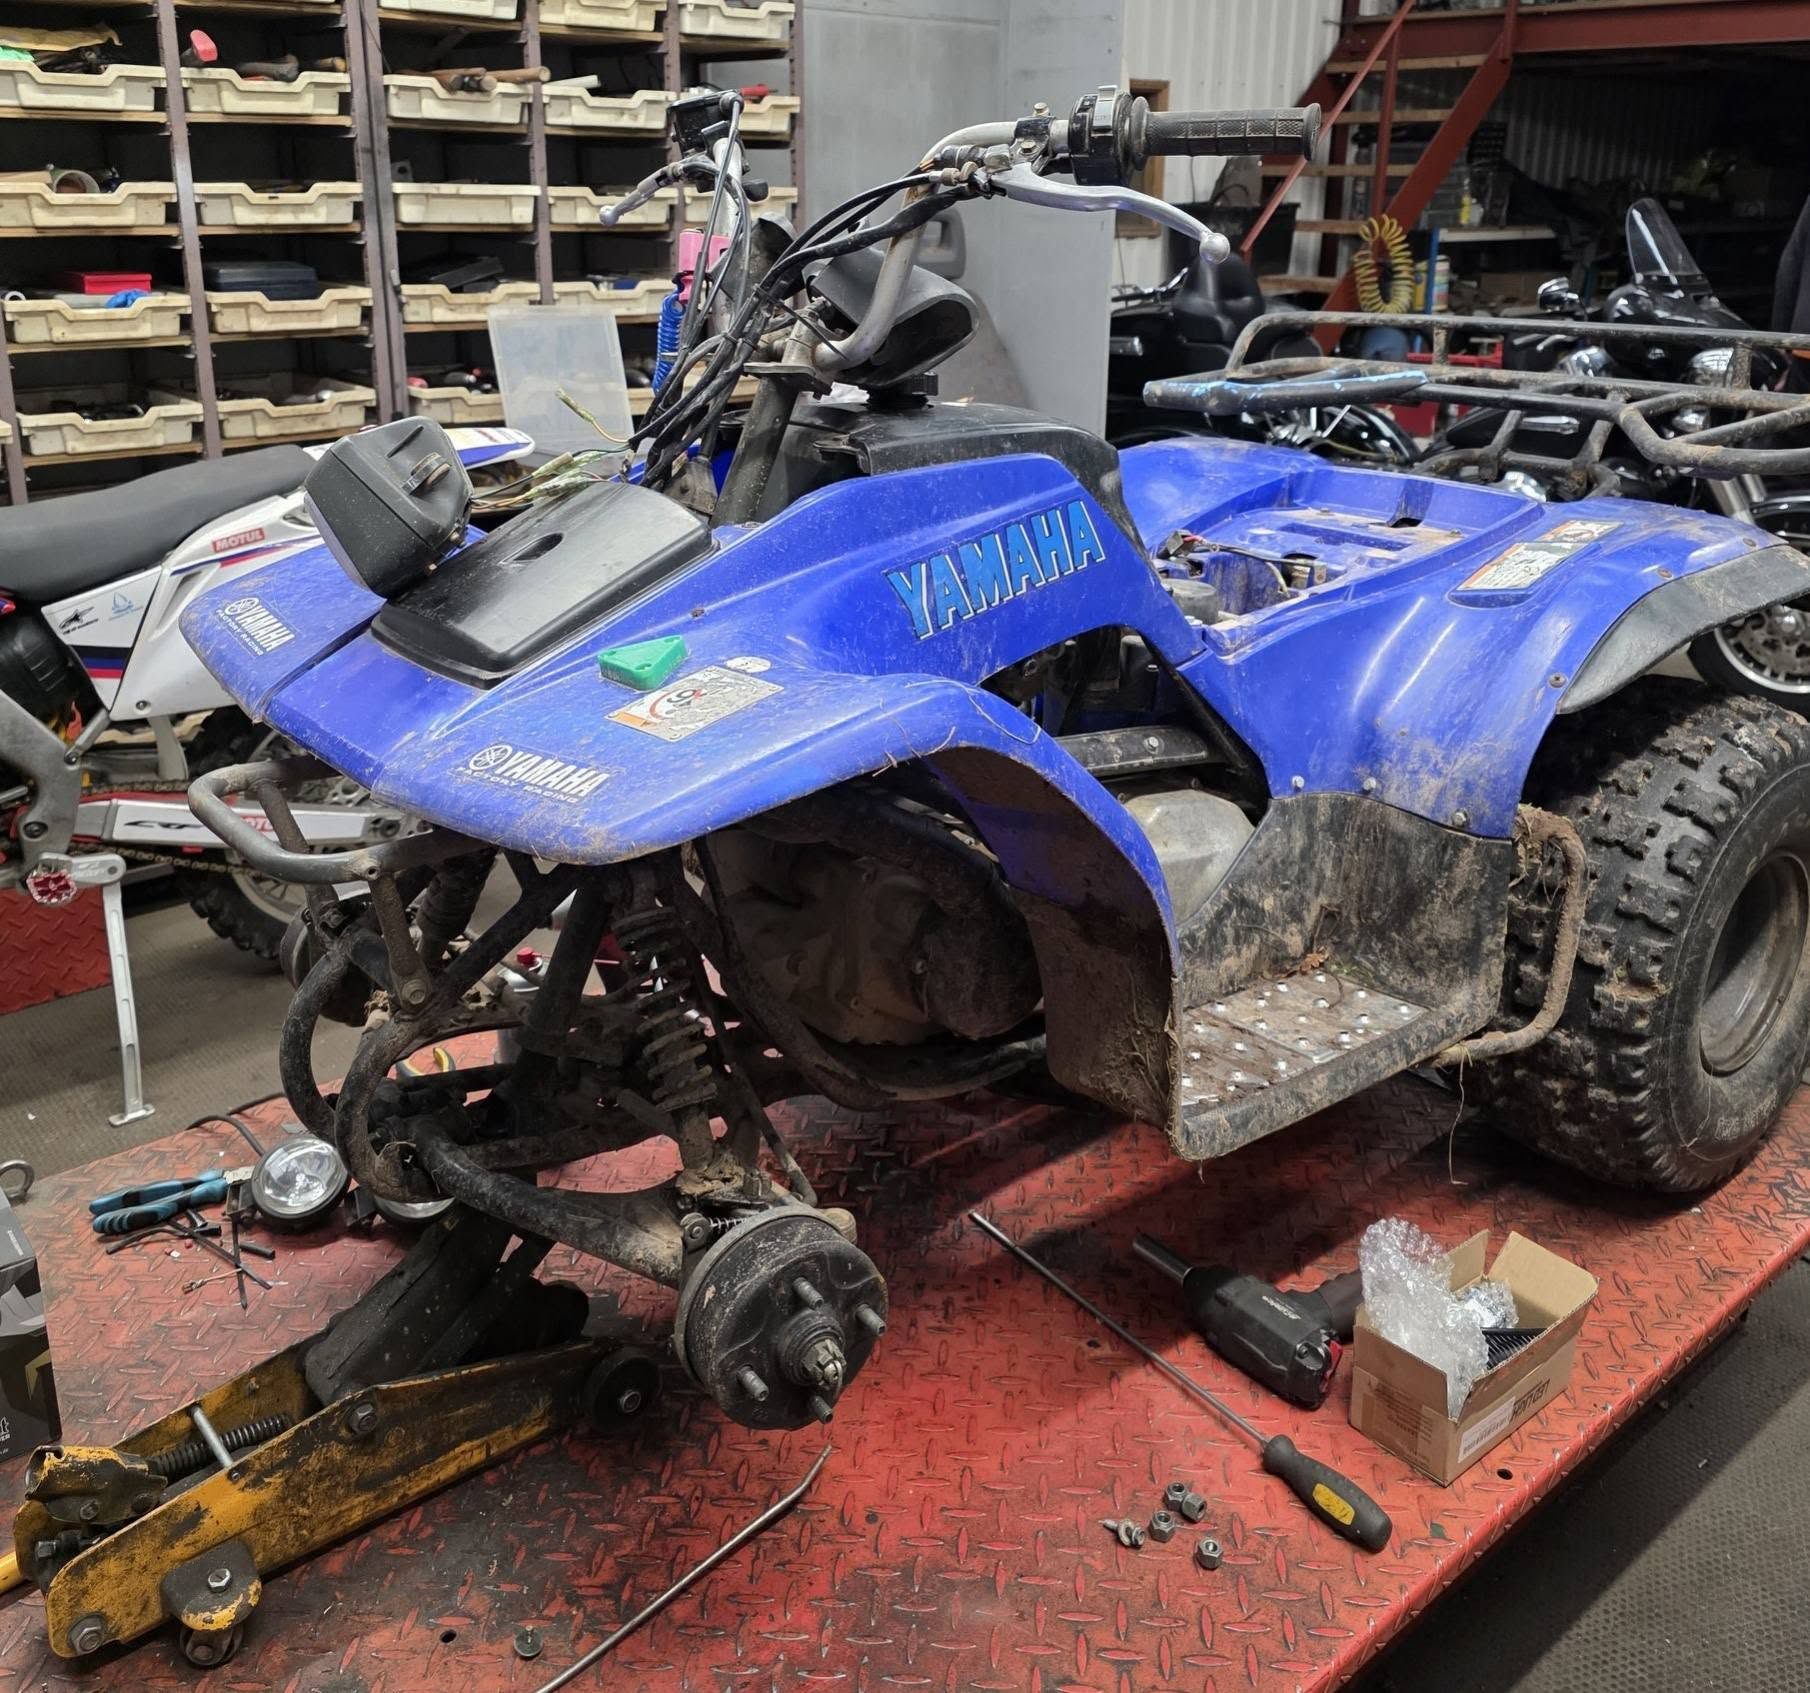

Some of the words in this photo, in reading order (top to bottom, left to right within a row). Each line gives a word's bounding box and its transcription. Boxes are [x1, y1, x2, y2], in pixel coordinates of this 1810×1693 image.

[215, 529, 264, 552] MOTUL
[887, 500, 1106, 640] YAMAHA
[216, 609, 242, 634] FACTORY
[240, 633, 264, 656] RACING
[235, 605, 295, 652] YAMAHA
[455, 766, 520, 787] FACTORY
[523, 785, 579, 803] RACING
[495, 751, 610, 796] YAMAHA
